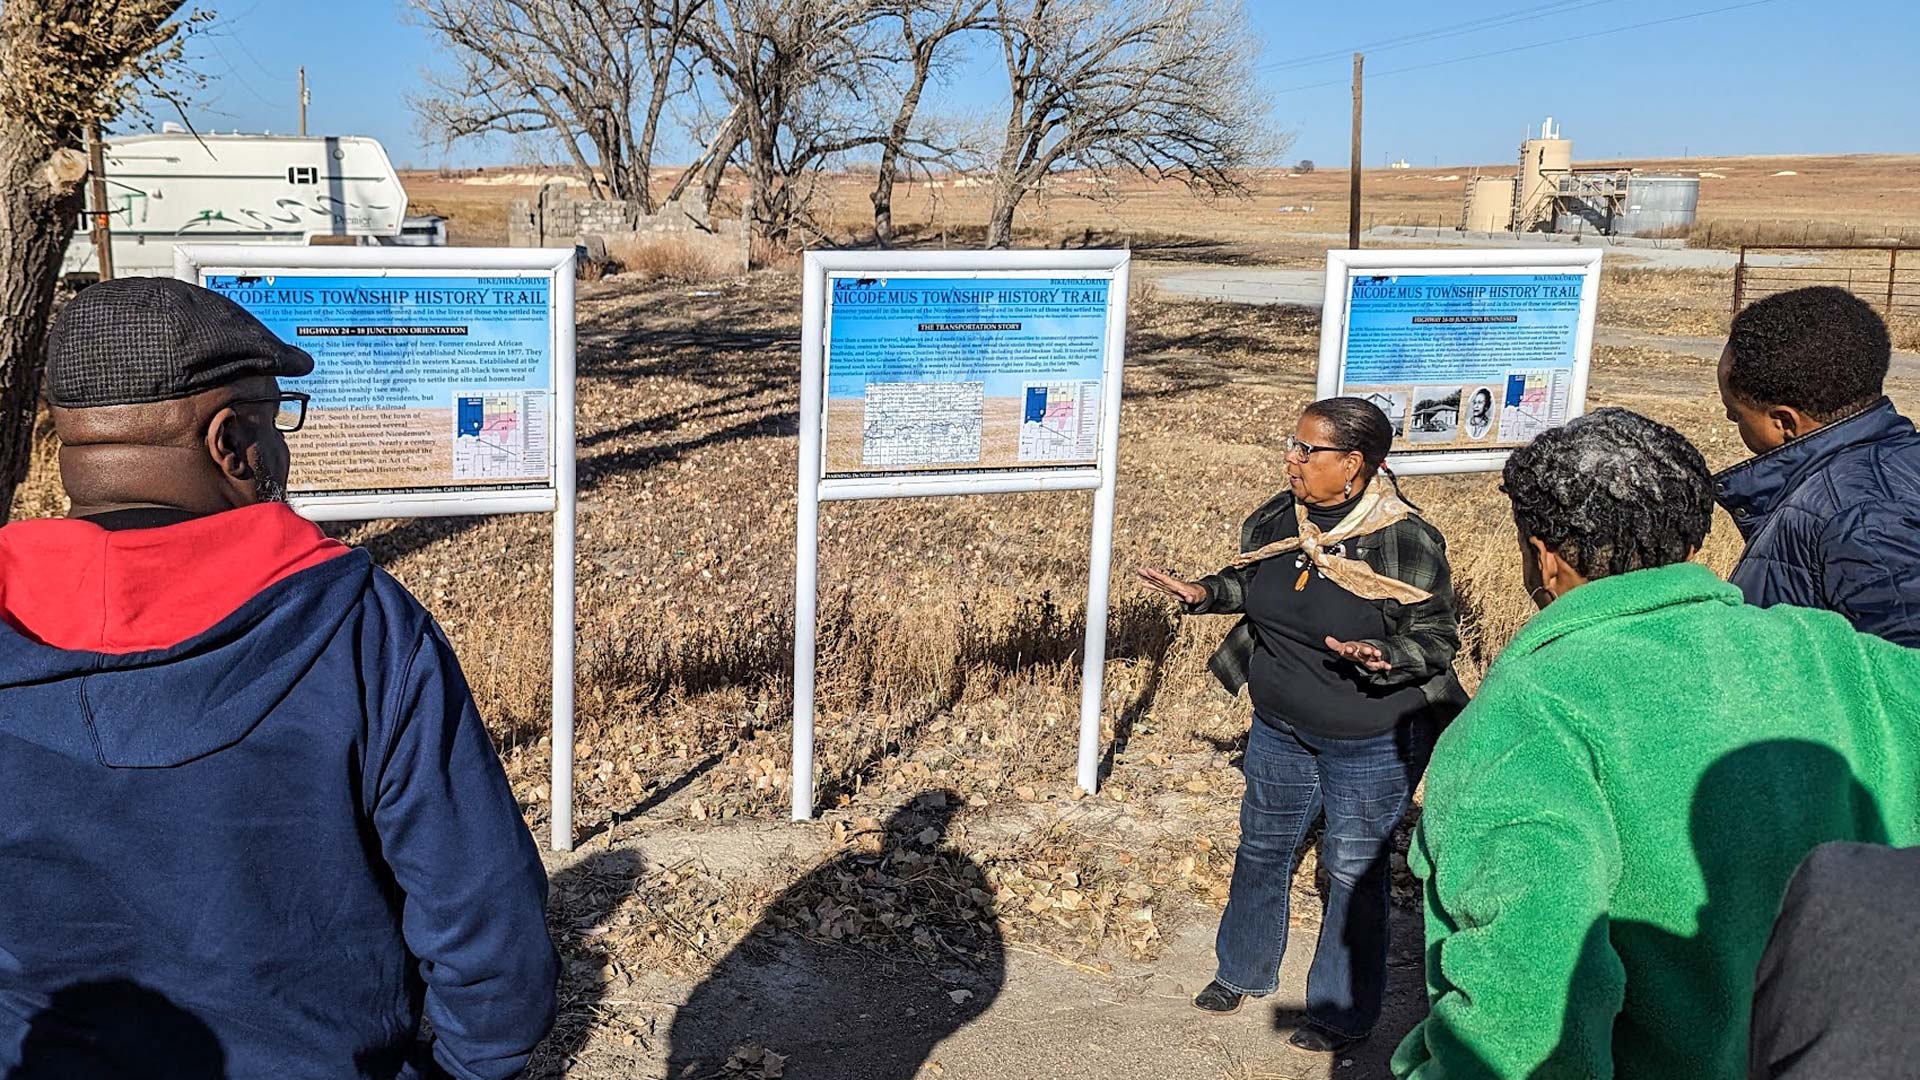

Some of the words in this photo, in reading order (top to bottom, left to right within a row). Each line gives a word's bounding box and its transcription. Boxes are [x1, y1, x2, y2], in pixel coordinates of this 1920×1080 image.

[478, 277, 547, 285] BIKE/HIKE/DRIVE
[222, 289, 314, 304] CODEMUS
[319, 286, 409, 304] TOWNSHIP
[415, 288, 489, 304] HISTORY
[493, 290, 546, 304] TRAIL
[834, 291, 918, 304] NICODEMUS
[921, 286, 994, 304] TOWNSHIP
[998, 288, 1059, 304] HISTORY
[1061, 290, 1105, 303] TRAIL
[1353, 287, 1422, 298] NICODEMUS
[1426, 283, 1487, 299] TOWNSHIP
[1489, 285, 1540, 298] HISTORY
[1543, 286, 1579, 298] TRAIL
[366, 327, 408, 335] JUNCTION
[936, 323, 996, 331] TRANSPORTATION
[373, 350, 414, 358] Mississippi
[526, 349, 542, 357] They
[423, 367, 459, 375] remaining
[301, 378, 339, 386] organizers
[373, 377, 391, 385] large
[338, 386, 373, 394] township
[374, 386, 388, 394] (see
[292, 450, 329, 458] epartment
